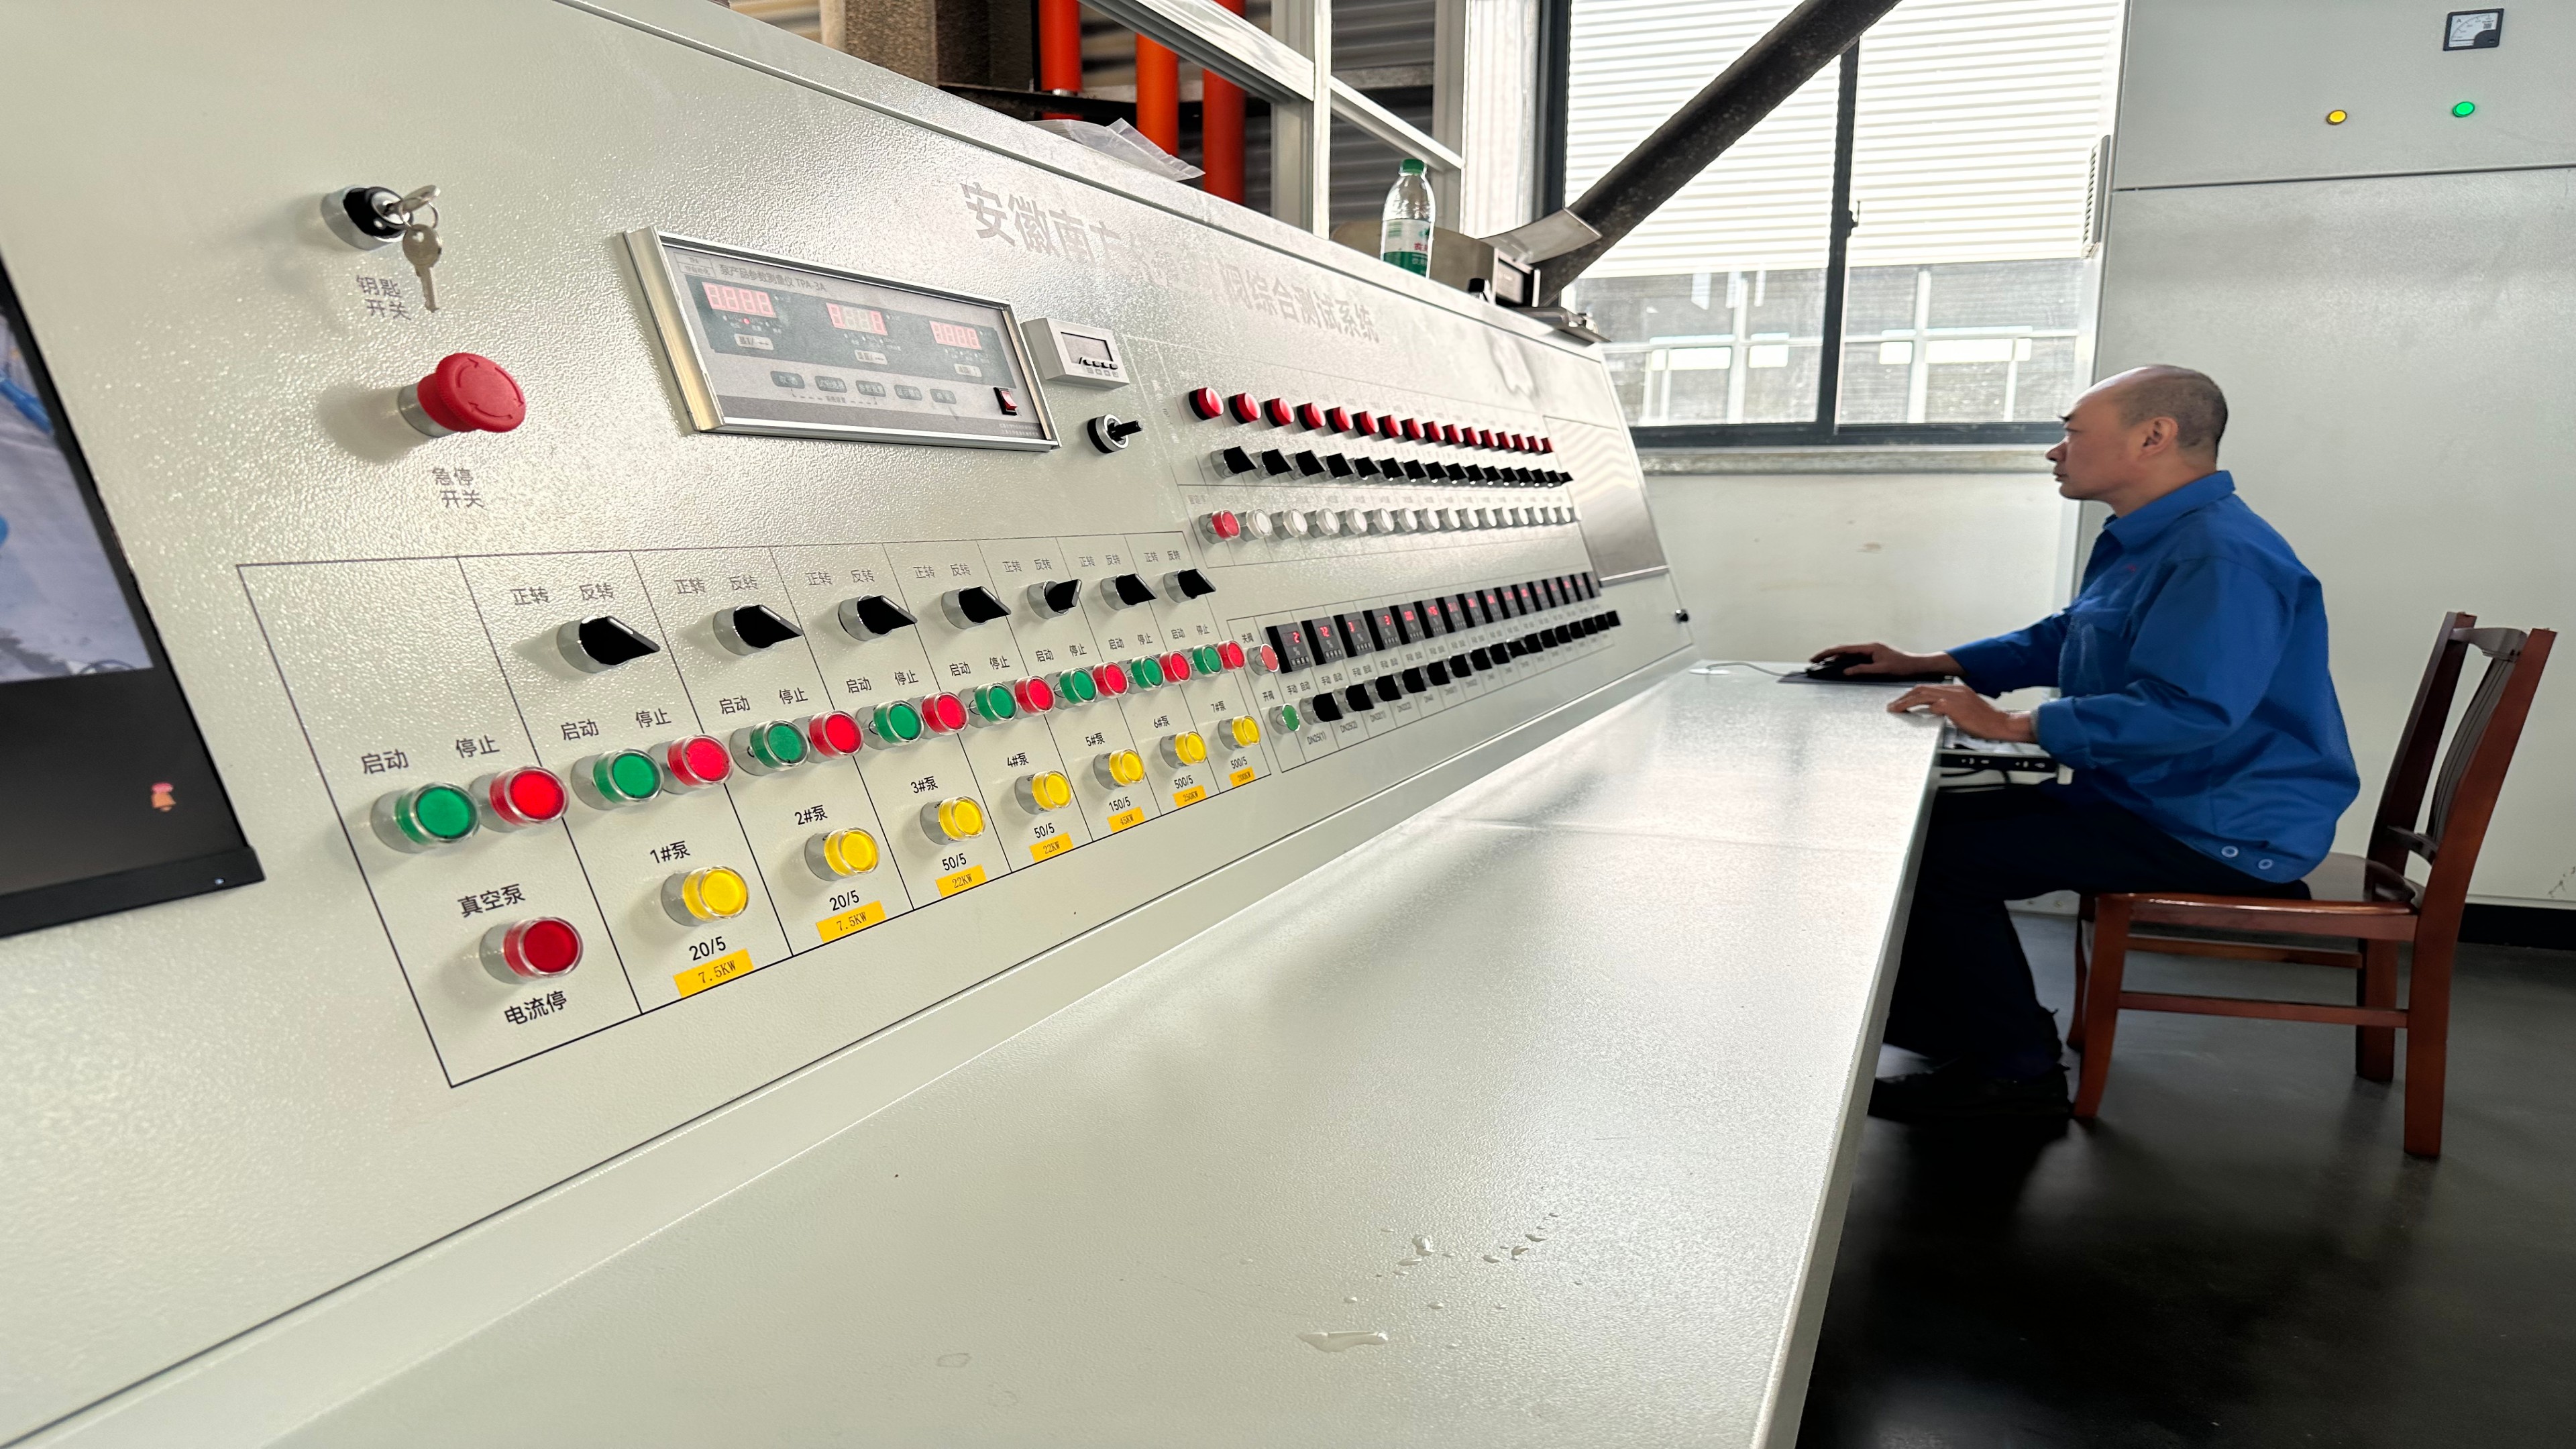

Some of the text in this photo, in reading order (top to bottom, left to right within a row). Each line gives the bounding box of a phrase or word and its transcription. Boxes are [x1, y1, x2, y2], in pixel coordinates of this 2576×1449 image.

[356, 274, 401, 299] 钥匙
[366, 298, 412, 321] 开关
[431, 468, 474, 487] 急停
[440, 490, 486, 509] 开关
[1003, 558, 1053, 573] 正转 反转
[1079, 553, 1121, 568] 正转 反转
[806, 568, 875, 586] 正转 反转
[913, 562, 971, 580] 正转 反转
[676, 575, 759, 594] 正转 反转
[510, 584, 614, 605] 正转 反转
[1108, 633, 1153, 651] 启动 停止
[1171, 625, 1210, 641] 启动 停止
[1036, 643, 1088, 663] 启动 停止
[949, 656, 1011, 677] 启动 停止
[846, 671, 919, 694] 启动 停止
[718, 688, 809, 714] 启动 停止
[1210, 700, 1226, 712] 7#泵
[561, 708, 672, 741] 启动 停止
[1154, 715, 1171, 729] 6#泵
[1085, 732, 1105, 747] 5#泵
[361, 735, 500, 774] 启动 停止
[1007, 752, 1029, 767] 4#泵
[1230, 756, 1248, 769] 500/5
[910, 775, 938, 794] 3#泵
[1174, 775, 1193, 789] 500/5
[1109, 796, 1131, 812] 150/5
[794, 804, 828, 826] 2#泵
[1119, 814, 1134, 826] 45KW
[1034, 822, 1055, 839] 50/5
[649, 841, 691, 865] 1#泵
[1042, 841, 1061, 855] 22KW
[942, 853, 967, 871] 50/5
[951, 873, 974, 889] 22KW
[458, 883, 526, 918] 真空泵
[829, 890, 860, 911] 20/5
[837, 911, 868, 932] 7.5KW
[689, 936, 727, 962] 20/5
[698, 960, 737, 984] 7.5KW
[504, 990, 568, 1026] 电流停
